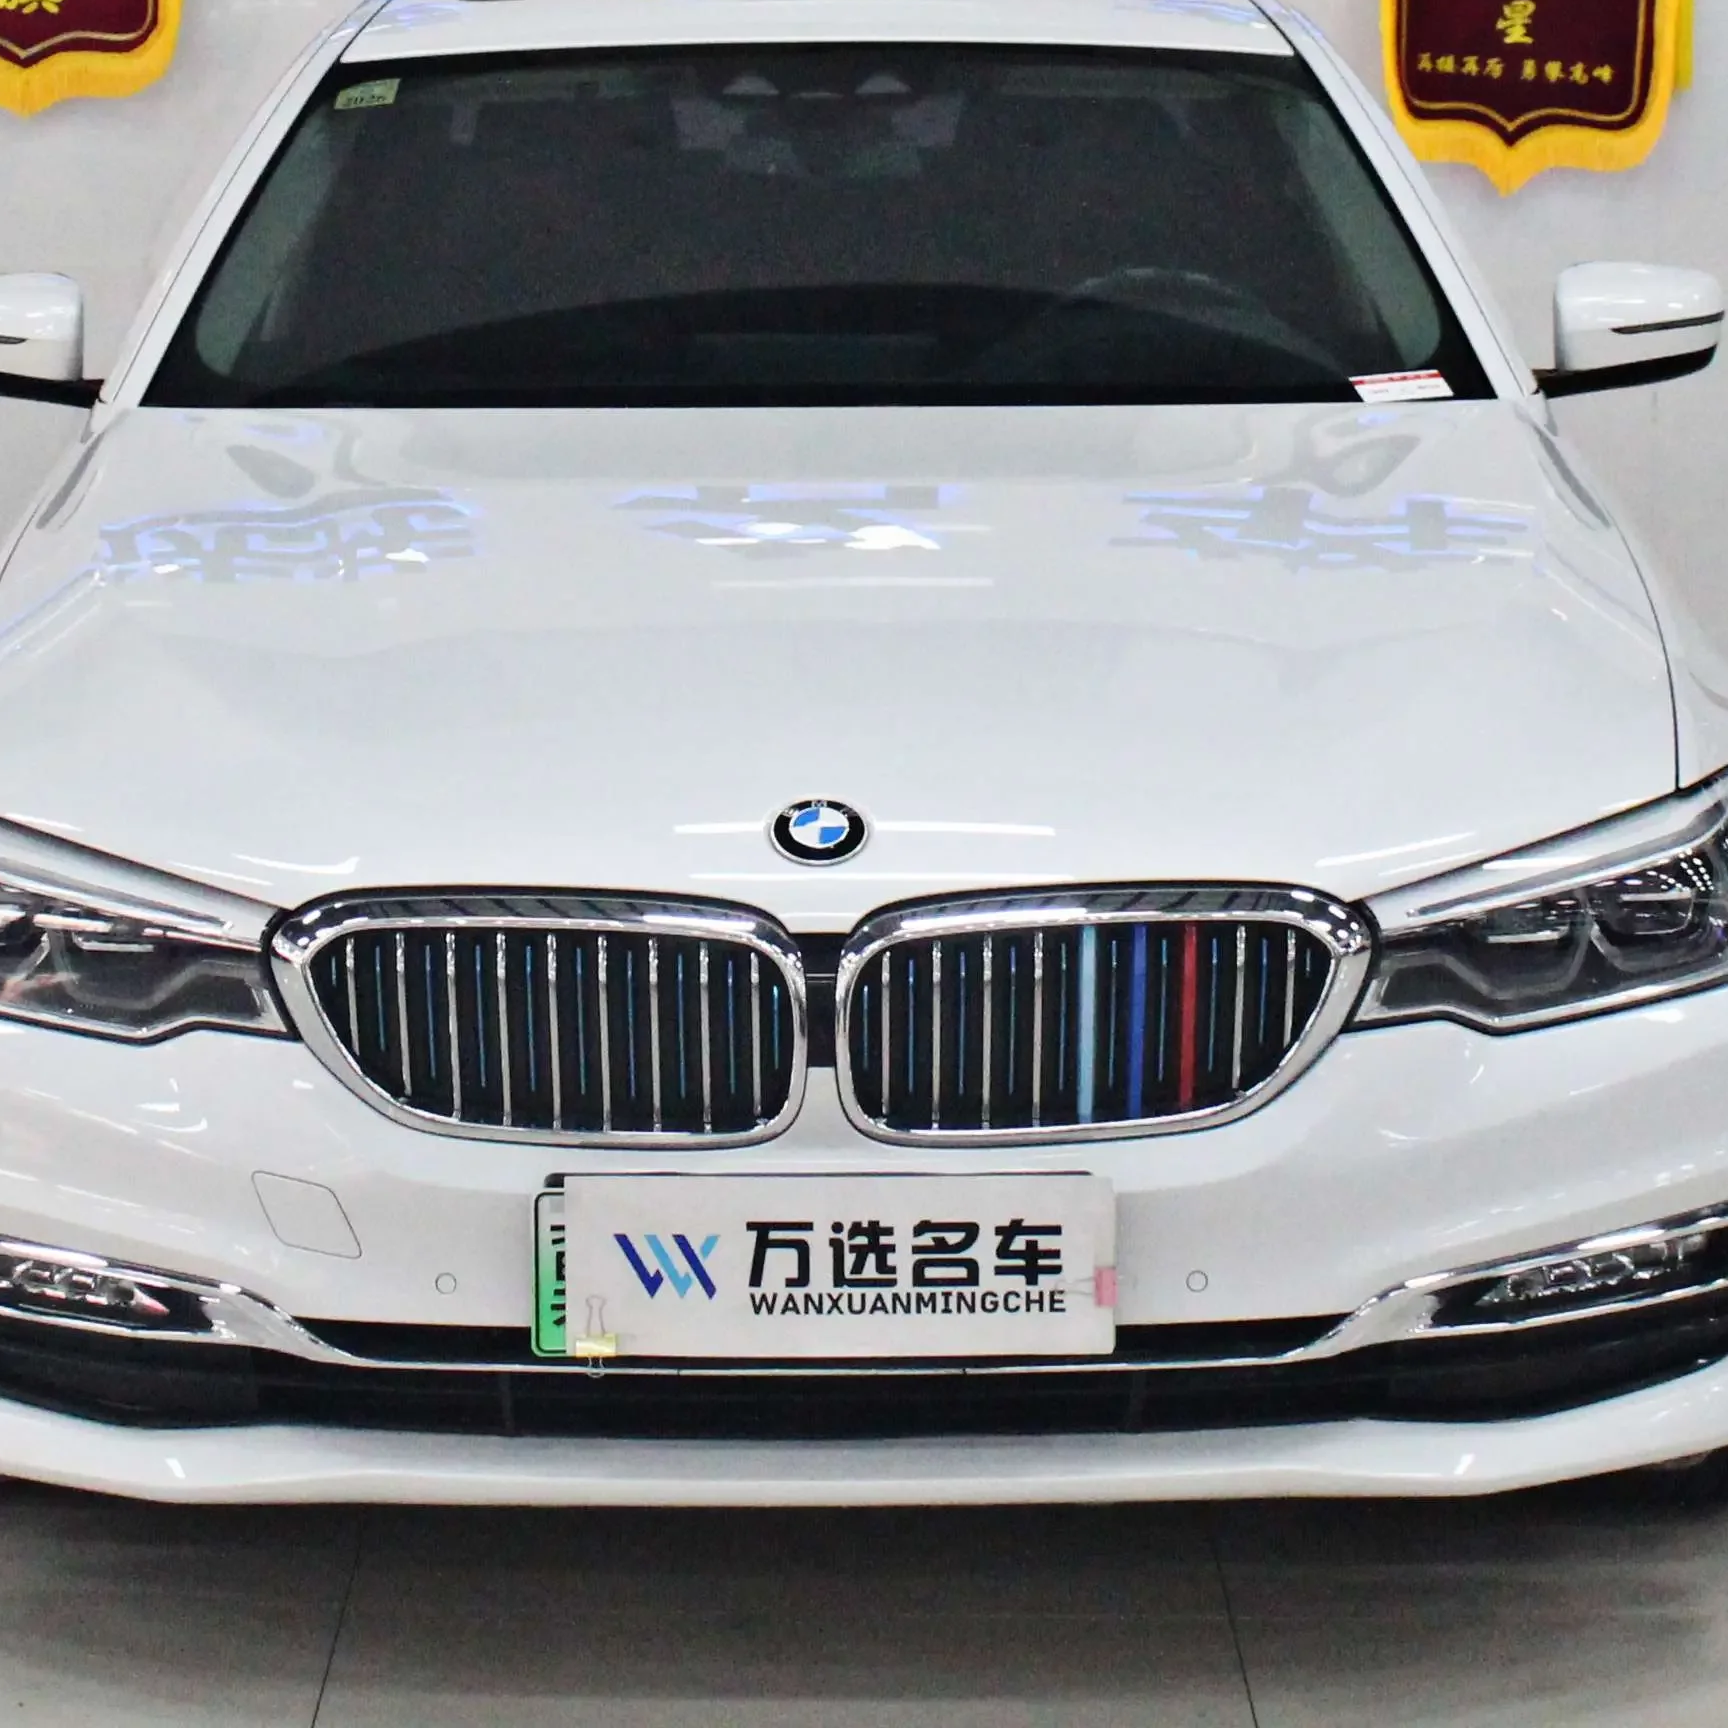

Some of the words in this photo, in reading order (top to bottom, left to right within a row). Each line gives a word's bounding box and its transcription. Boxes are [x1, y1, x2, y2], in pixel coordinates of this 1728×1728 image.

[745, 1218, 1063, 1288] 万选名车
[749, 1290, 1067, 1316] WANXUANMINGCHE
